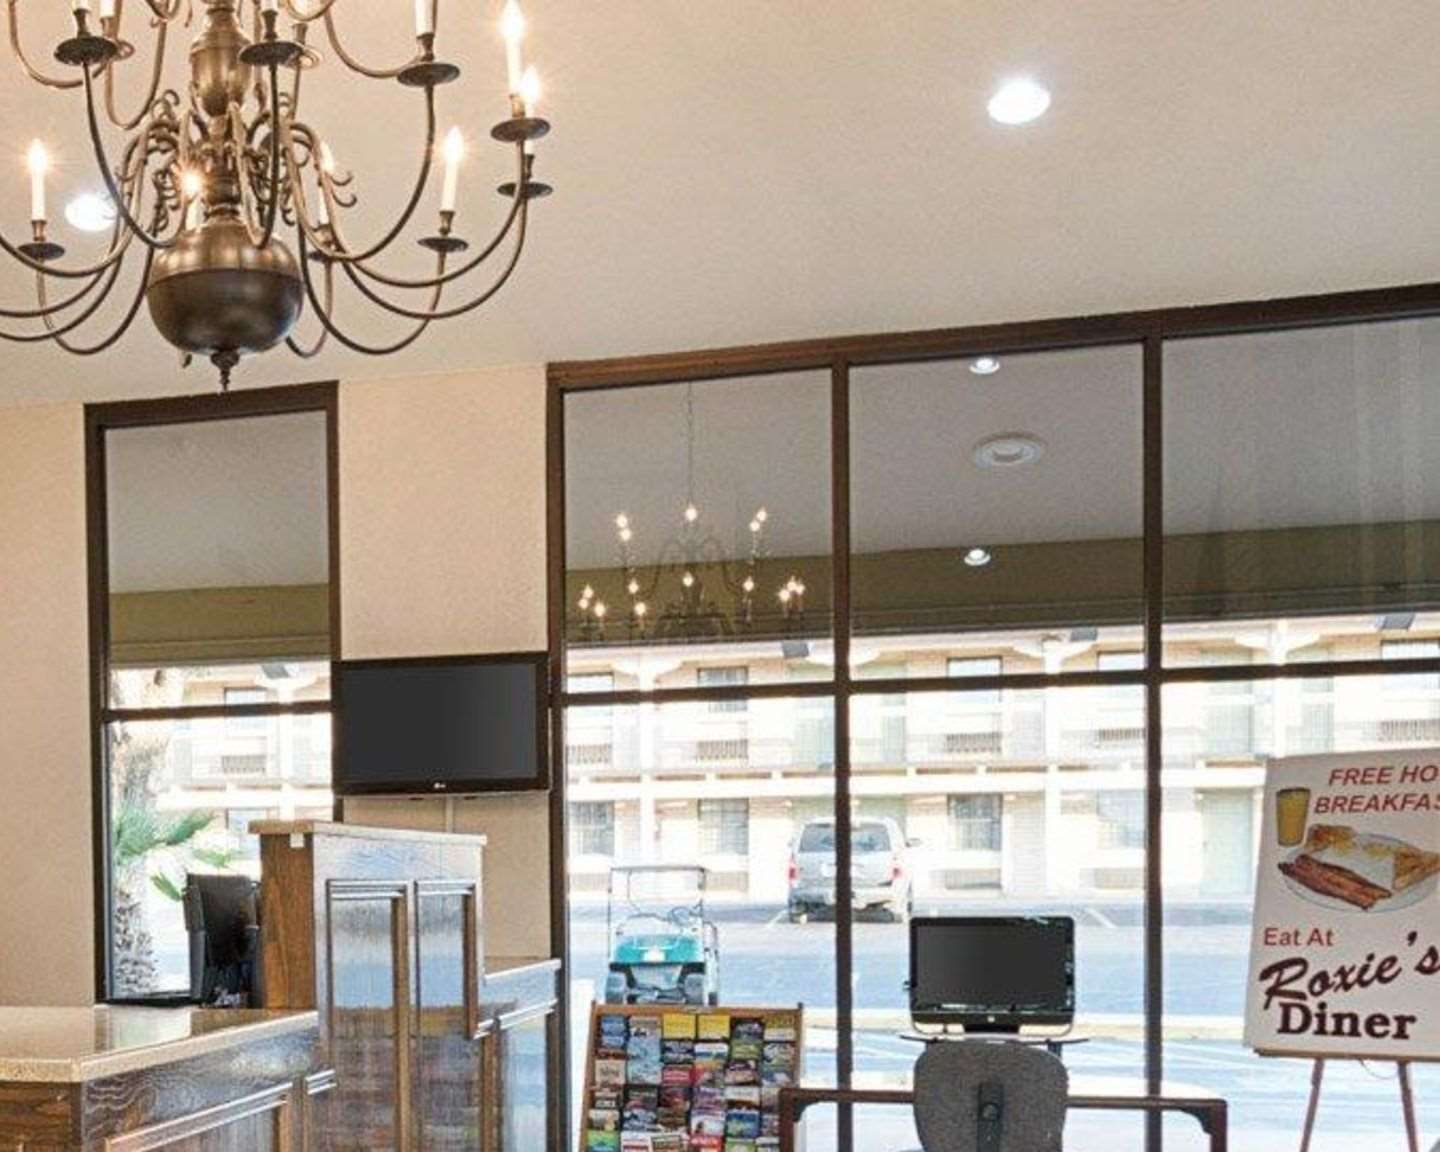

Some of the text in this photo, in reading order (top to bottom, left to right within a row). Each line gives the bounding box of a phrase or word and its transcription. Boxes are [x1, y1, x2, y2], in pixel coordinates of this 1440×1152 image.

[1328, 766, 1394, 786] FREE
[1264, 927, 1334, 946] Eat At
[1258, 928, 1440, 1010] Roxie's
[1276, 1001, 1417, 1040] Diner
